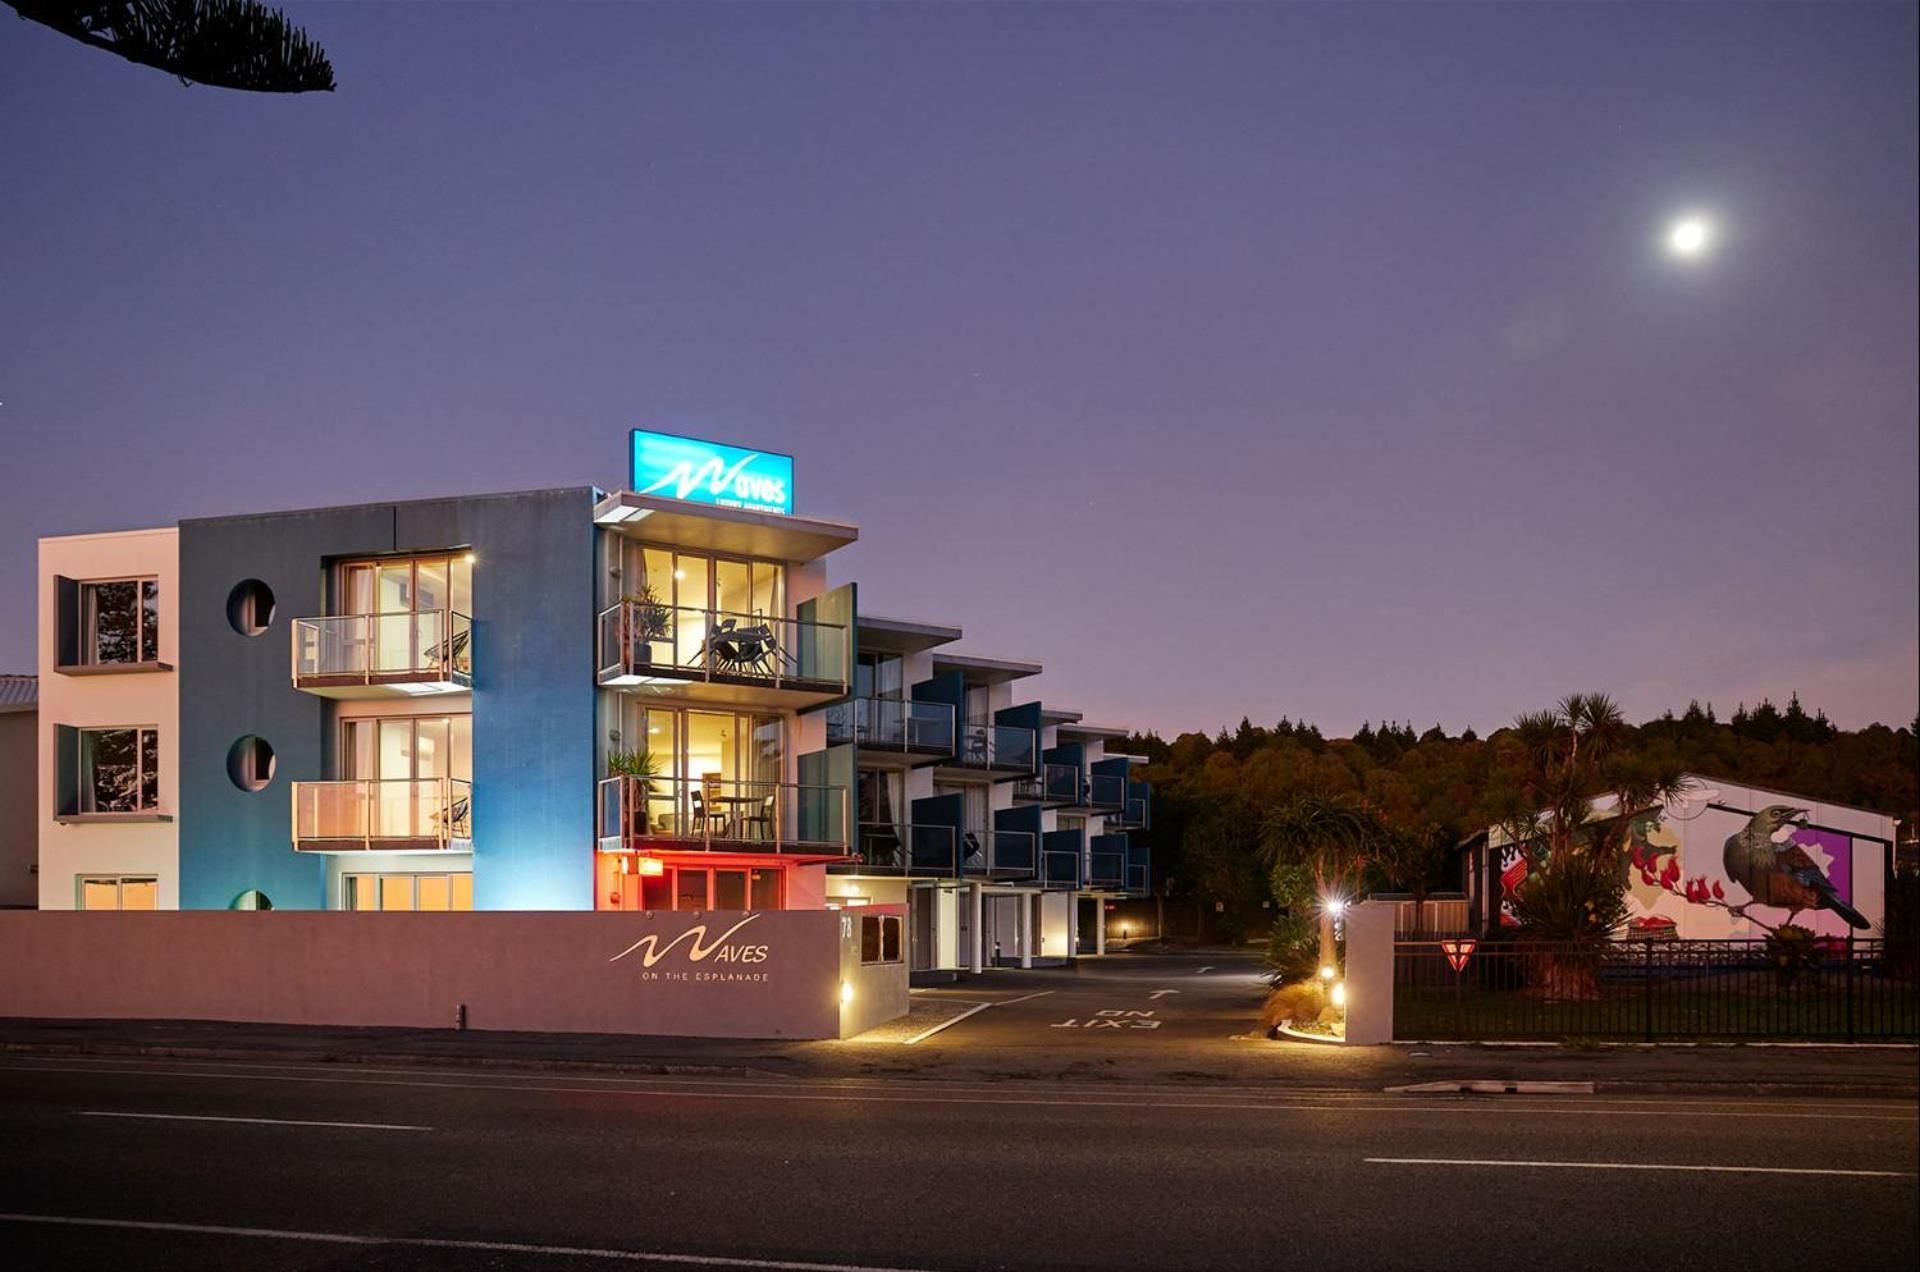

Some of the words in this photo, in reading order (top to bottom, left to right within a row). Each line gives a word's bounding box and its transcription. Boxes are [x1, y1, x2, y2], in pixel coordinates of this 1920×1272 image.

[609, 913, 769, 968] WAVES
[642, 972, 658, 981] ON
[666, 973, 689, 982] THE
[695, 973, 769, 982] ESPLANADE
[1096, 1009, 1155, 1017] NO
[1050, 1019, 1162, 1029] EXIT
